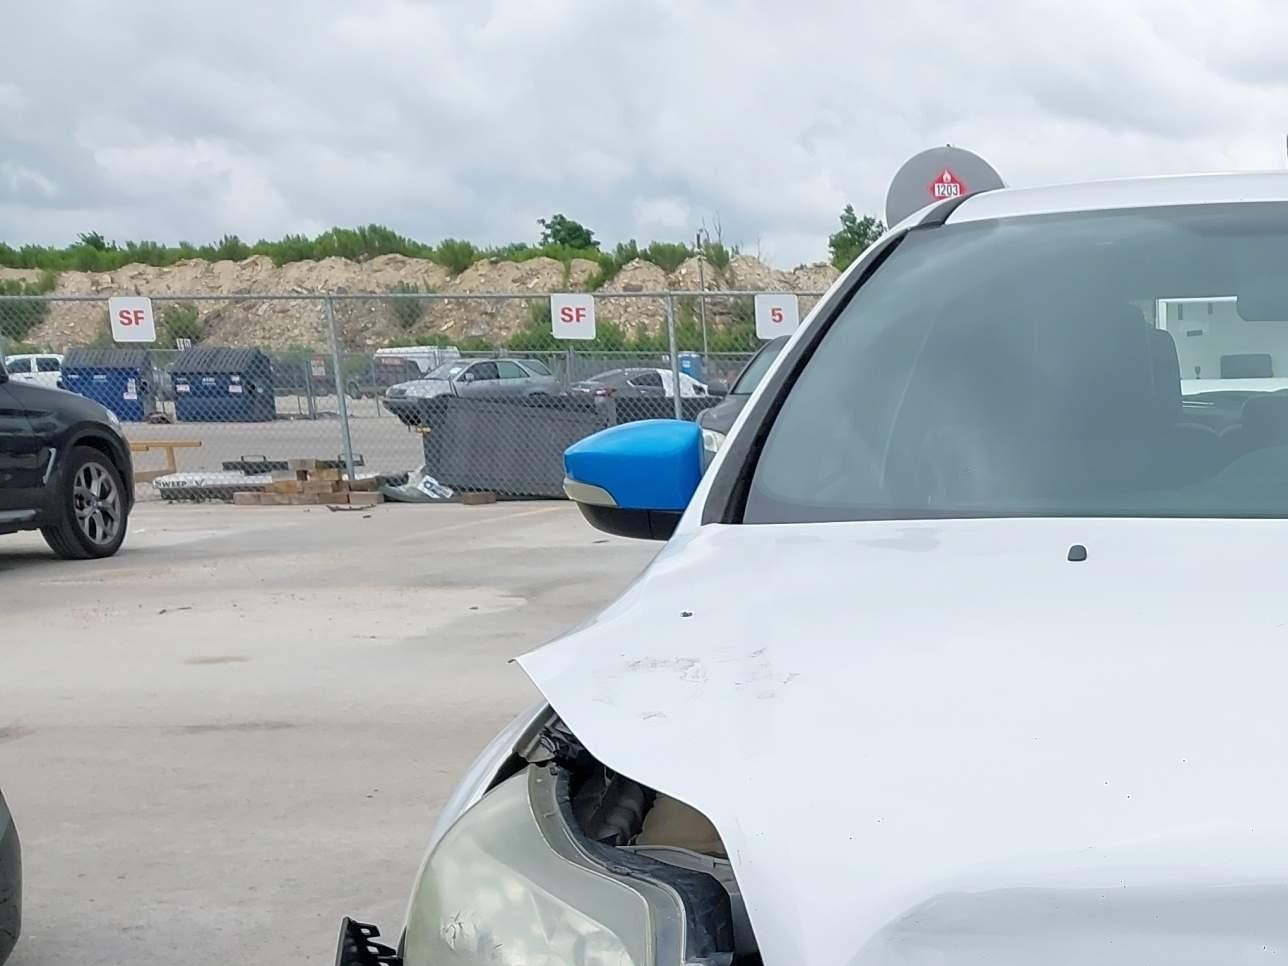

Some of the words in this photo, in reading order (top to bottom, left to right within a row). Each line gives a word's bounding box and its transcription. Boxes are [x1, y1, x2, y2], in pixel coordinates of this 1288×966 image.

[937, 184, 959, 196] 1203
[119, 309, 144, 326] SF
[560, 307, 586, 323] SF
[771, 308, 783, 323] 5
